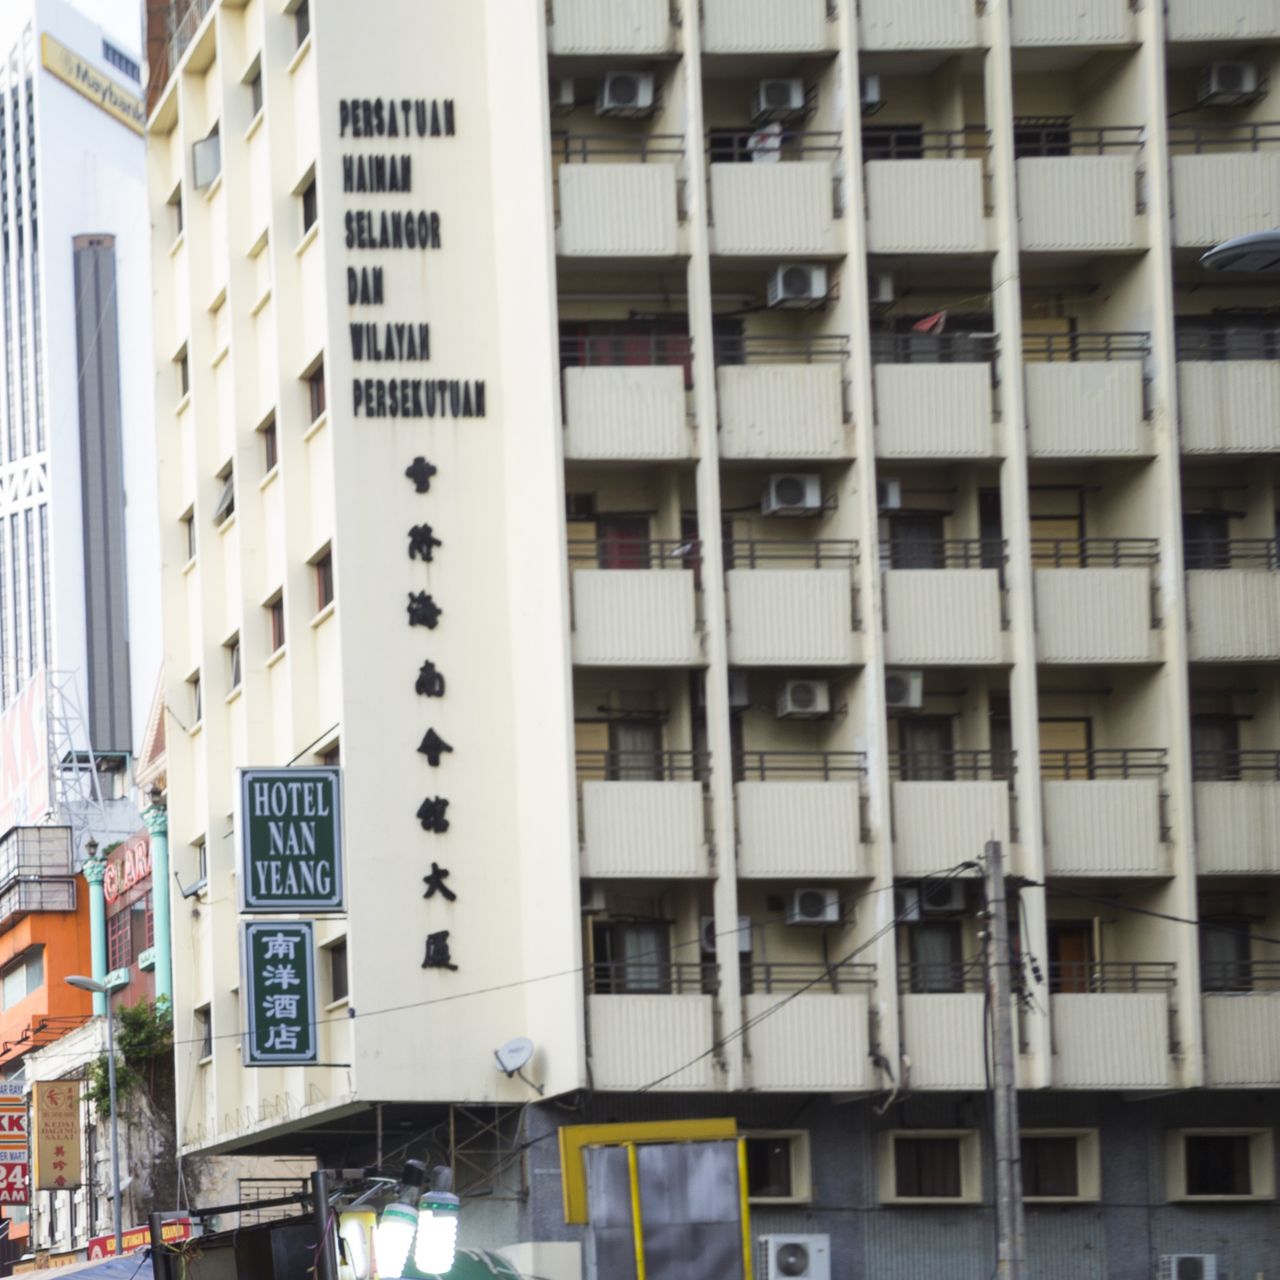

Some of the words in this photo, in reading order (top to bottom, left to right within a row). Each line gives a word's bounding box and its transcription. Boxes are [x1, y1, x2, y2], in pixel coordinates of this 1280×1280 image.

[340, 98, 456, 138] PERSATUAN
[343, 154, 412, 193] HAINAN
[344, 210, 441, 249] SELANGOR
[347, 266, 384, 305] DAN
[350, 322, 430, 361] WILAYAH
[352, 378, 486, 418] PERSEKUTUAN
[253, 781, 330, 817] HOTEL
[268, 821, 316, 855] NAN
[255, 860, 331, 895] YEANG
[261, 933, 302, 1050] 南洋酒店
[10, 1151, 26, 1160] MART
